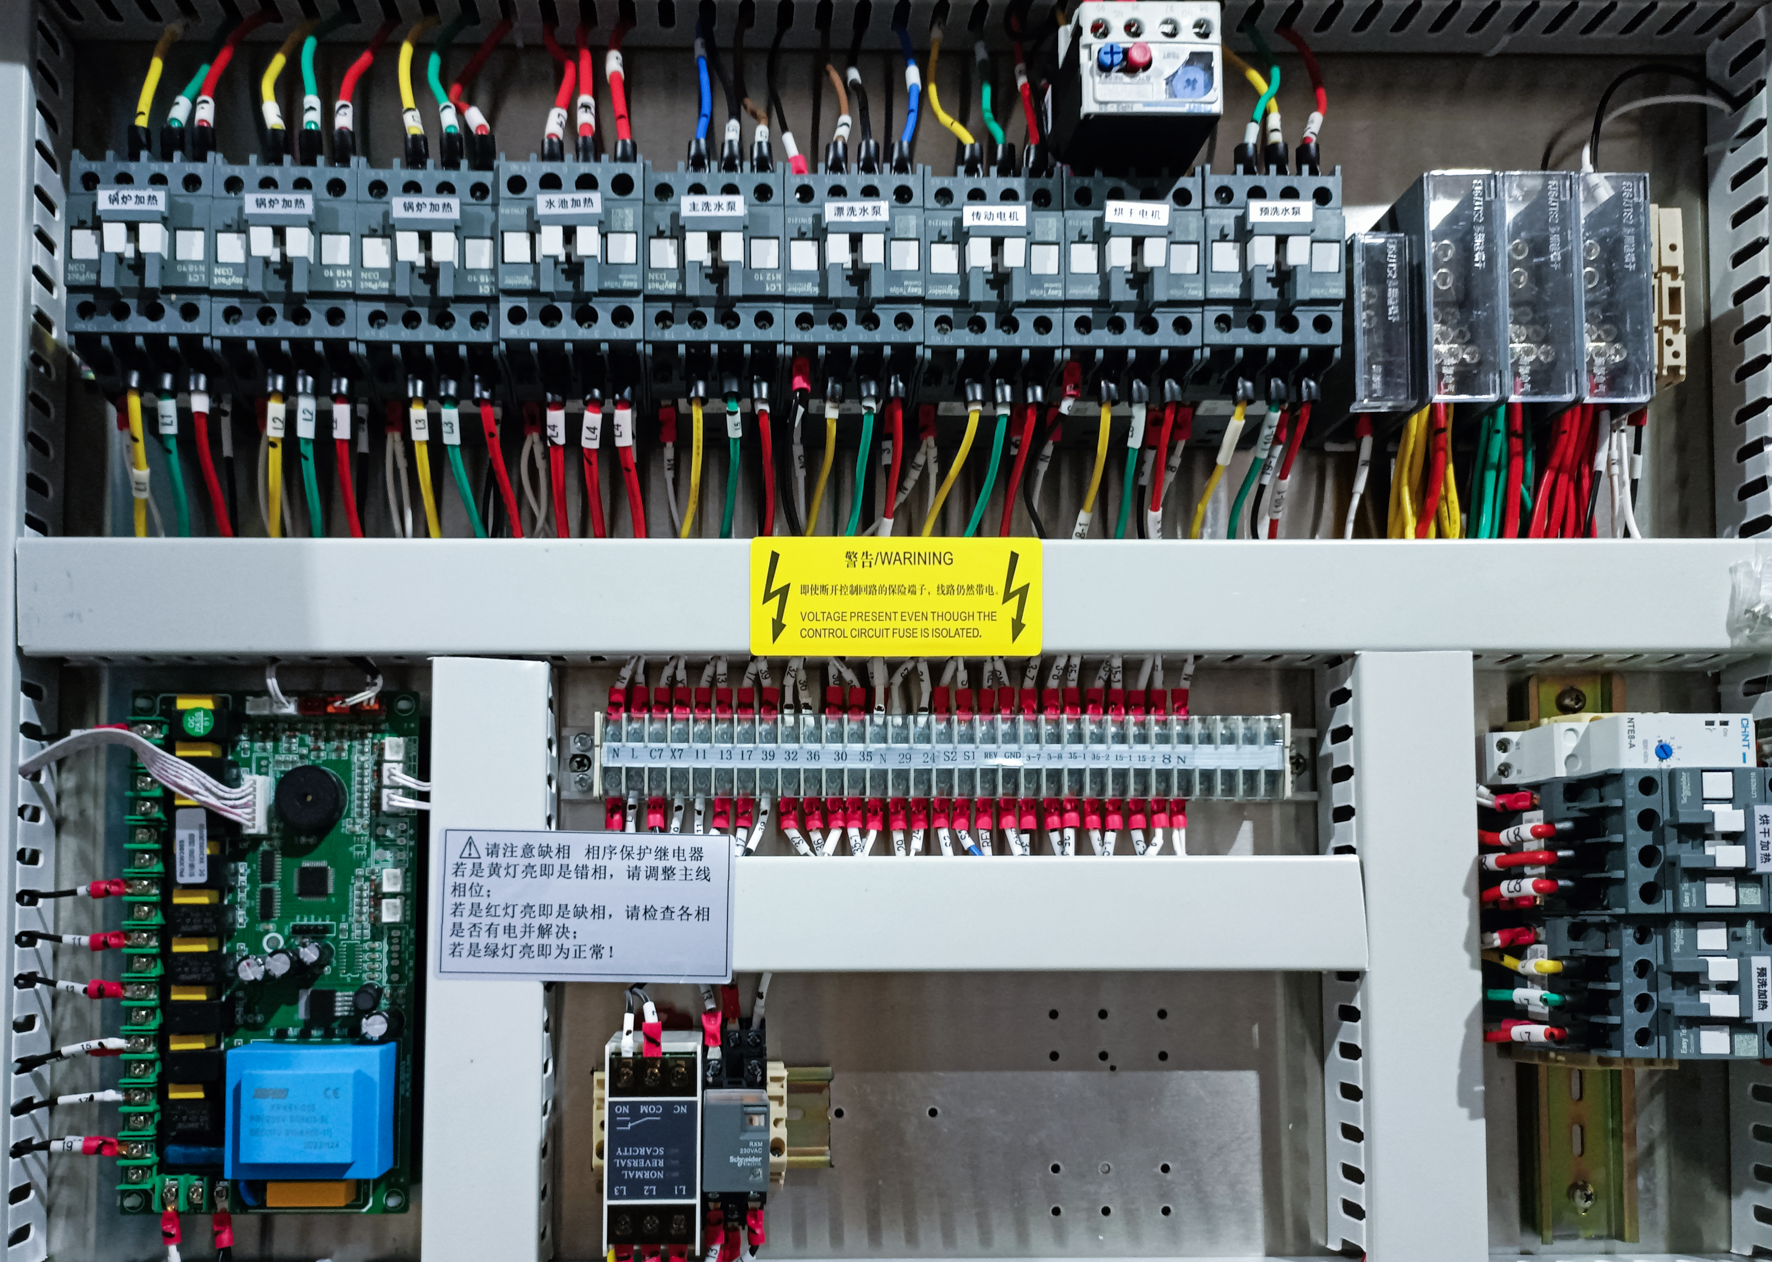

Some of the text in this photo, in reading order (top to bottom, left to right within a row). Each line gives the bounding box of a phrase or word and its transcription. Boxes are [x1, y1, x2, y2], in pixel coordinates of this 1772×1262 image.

[108, 192, 158, 206] 锅炉加热
[256, 197, 305, 209] 锅炉加热
[545, 198, 594, 210] 水池加热
[403, 201, 453, 213] 锅炉加热
[688, 201, 737, 213] 主洗水泵
[834, 205, 882, 218] 漂洗水泵
[1259, 206, 1302, 217] 预洗水泵
[971, 210, 1020, 222] 传动电机
[214, 267, 233, 276] D3N
[324, 268, 352, 278] N18 10
[361, 272, 380, 280] D3N
[336, 280, 352, 288] LC1
[160, 414, 174, 426] L1
[302, 408, 313, 422] L2
[272, 416, 284, 431] L2
[416, 418, 426, 430] L3
[444, 421, 454, 434] L3
[585, 426, 597, 441] L4
[844, 550, 954, 568] 警告/WARINING
[800, 611, 997, 622] VOLTAGE PRESENT EVEN THOUGH THE
[800, 628, 982, 638] CONTROL CIRCUIT FUSE IS ISOLATED.
[717, 673, 728, 684] 13
[760, 670, 770, 680] 39
[786, 666, 798, 679] 32
[1026, 664, 1038, 681] 3-7
[188, 716, 195, 728] QC
[1627, 717, 1636, 749] NTE8-A
[612, 748, 620, 759] N
[631, 748, 638, 760] L
[649, 748, 664, 760] C7
[670, 748, 684, 760] X7
[695, 749, 706, 760] 11
[720, 750, 732, 760] 13
[740, 750, 753, 761] 17
[762, 750, 775, 762] 39
[784, 750, 798, 762] 32
[806, 750, 820, 762] 36
[834, 750, 848, 762] 30
[858, 750, 872, 762] 35
[880, 753, 886, 764] N
[898, 752, 912, 764] 29
[922, 752, 936, 764] 24
[944, 751, 958, 762] S2
[964, 751, 976, 762] S1
[1026, 753, 1042, 761] 3-7
[1068, 752, 1086, 760] 35-1
[1162, 754, 1172, 764] 8
[1176, 756, 1186, 764] N
[736, 838, 746, 848] 17
[1758, 814, 1772, 864] 烘干加热
[812, 840, 824, 851] 36
[485, 842, 704, 862] 请注意缺相 相序保护继电器
[451, 862, 712, 882] 若是黄灯亮即是错相，请调整主线
[450, 882, 492, 898] 相位；
[450, 902, 711, 922] 若是红灯亮即是缺相，请检查各相
[449, 922, 578, 940] 是否有电并解决；
[72, 936, 82, 946] 11
[448, 942, 614, 960] 若是绿灯亮即为正常！
[1756, 967, 1768, 1012] 预洗加热
[1680, 1038, 1688, 1054] Easy
[615, 1105, 688, 1114] NO COM NC
[62, 1140, 73, 1152] 19
[616, 1147, 664, 1155] SCARCITY
[614, 1158, 664, 1167] REVERSAL
[729, 1156, 762, 1164] Schneider
[622, 1170, 664, 1178] NORMAL
[614, 1186, 686, 1195] L3 L2 L1
